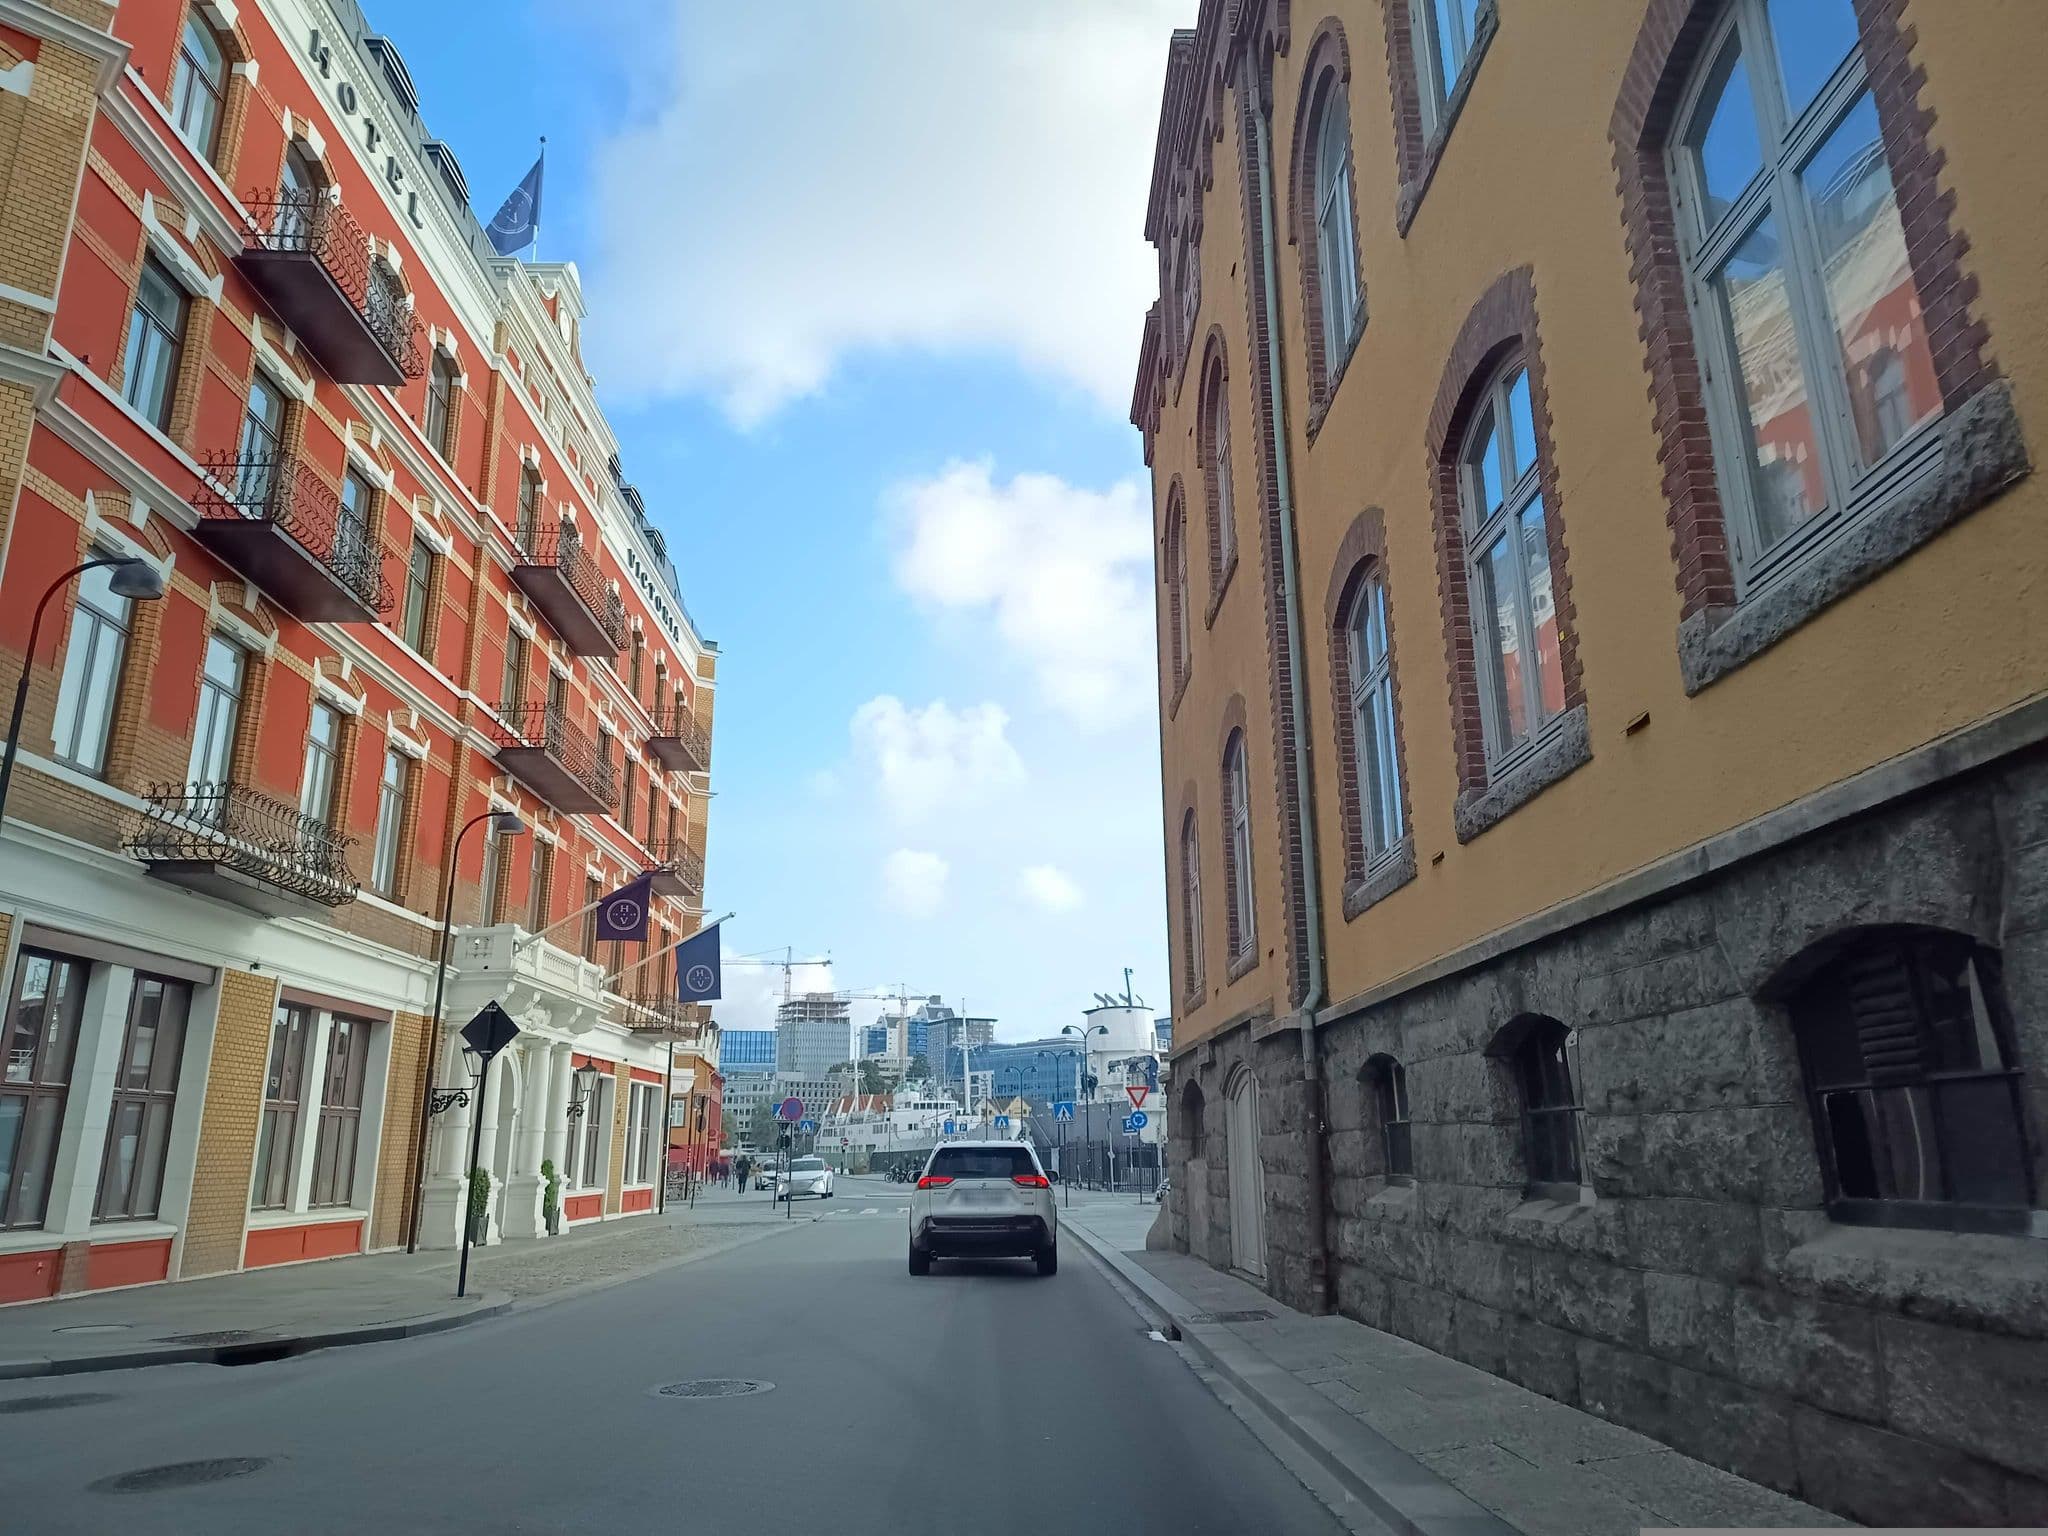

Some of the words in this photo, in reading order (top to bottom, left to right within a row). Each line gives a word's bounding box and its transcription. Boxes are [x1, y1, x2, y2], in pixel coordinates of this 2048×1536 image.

[309, 29, 423, 229] HOTEL
[627, 548, 679, 643] VICTORIA
[620, 904, 629, 913] H
[620, 916, 628, 925] V
[696, 969, 704, 977] H
[697, 980, 704, 988] V
